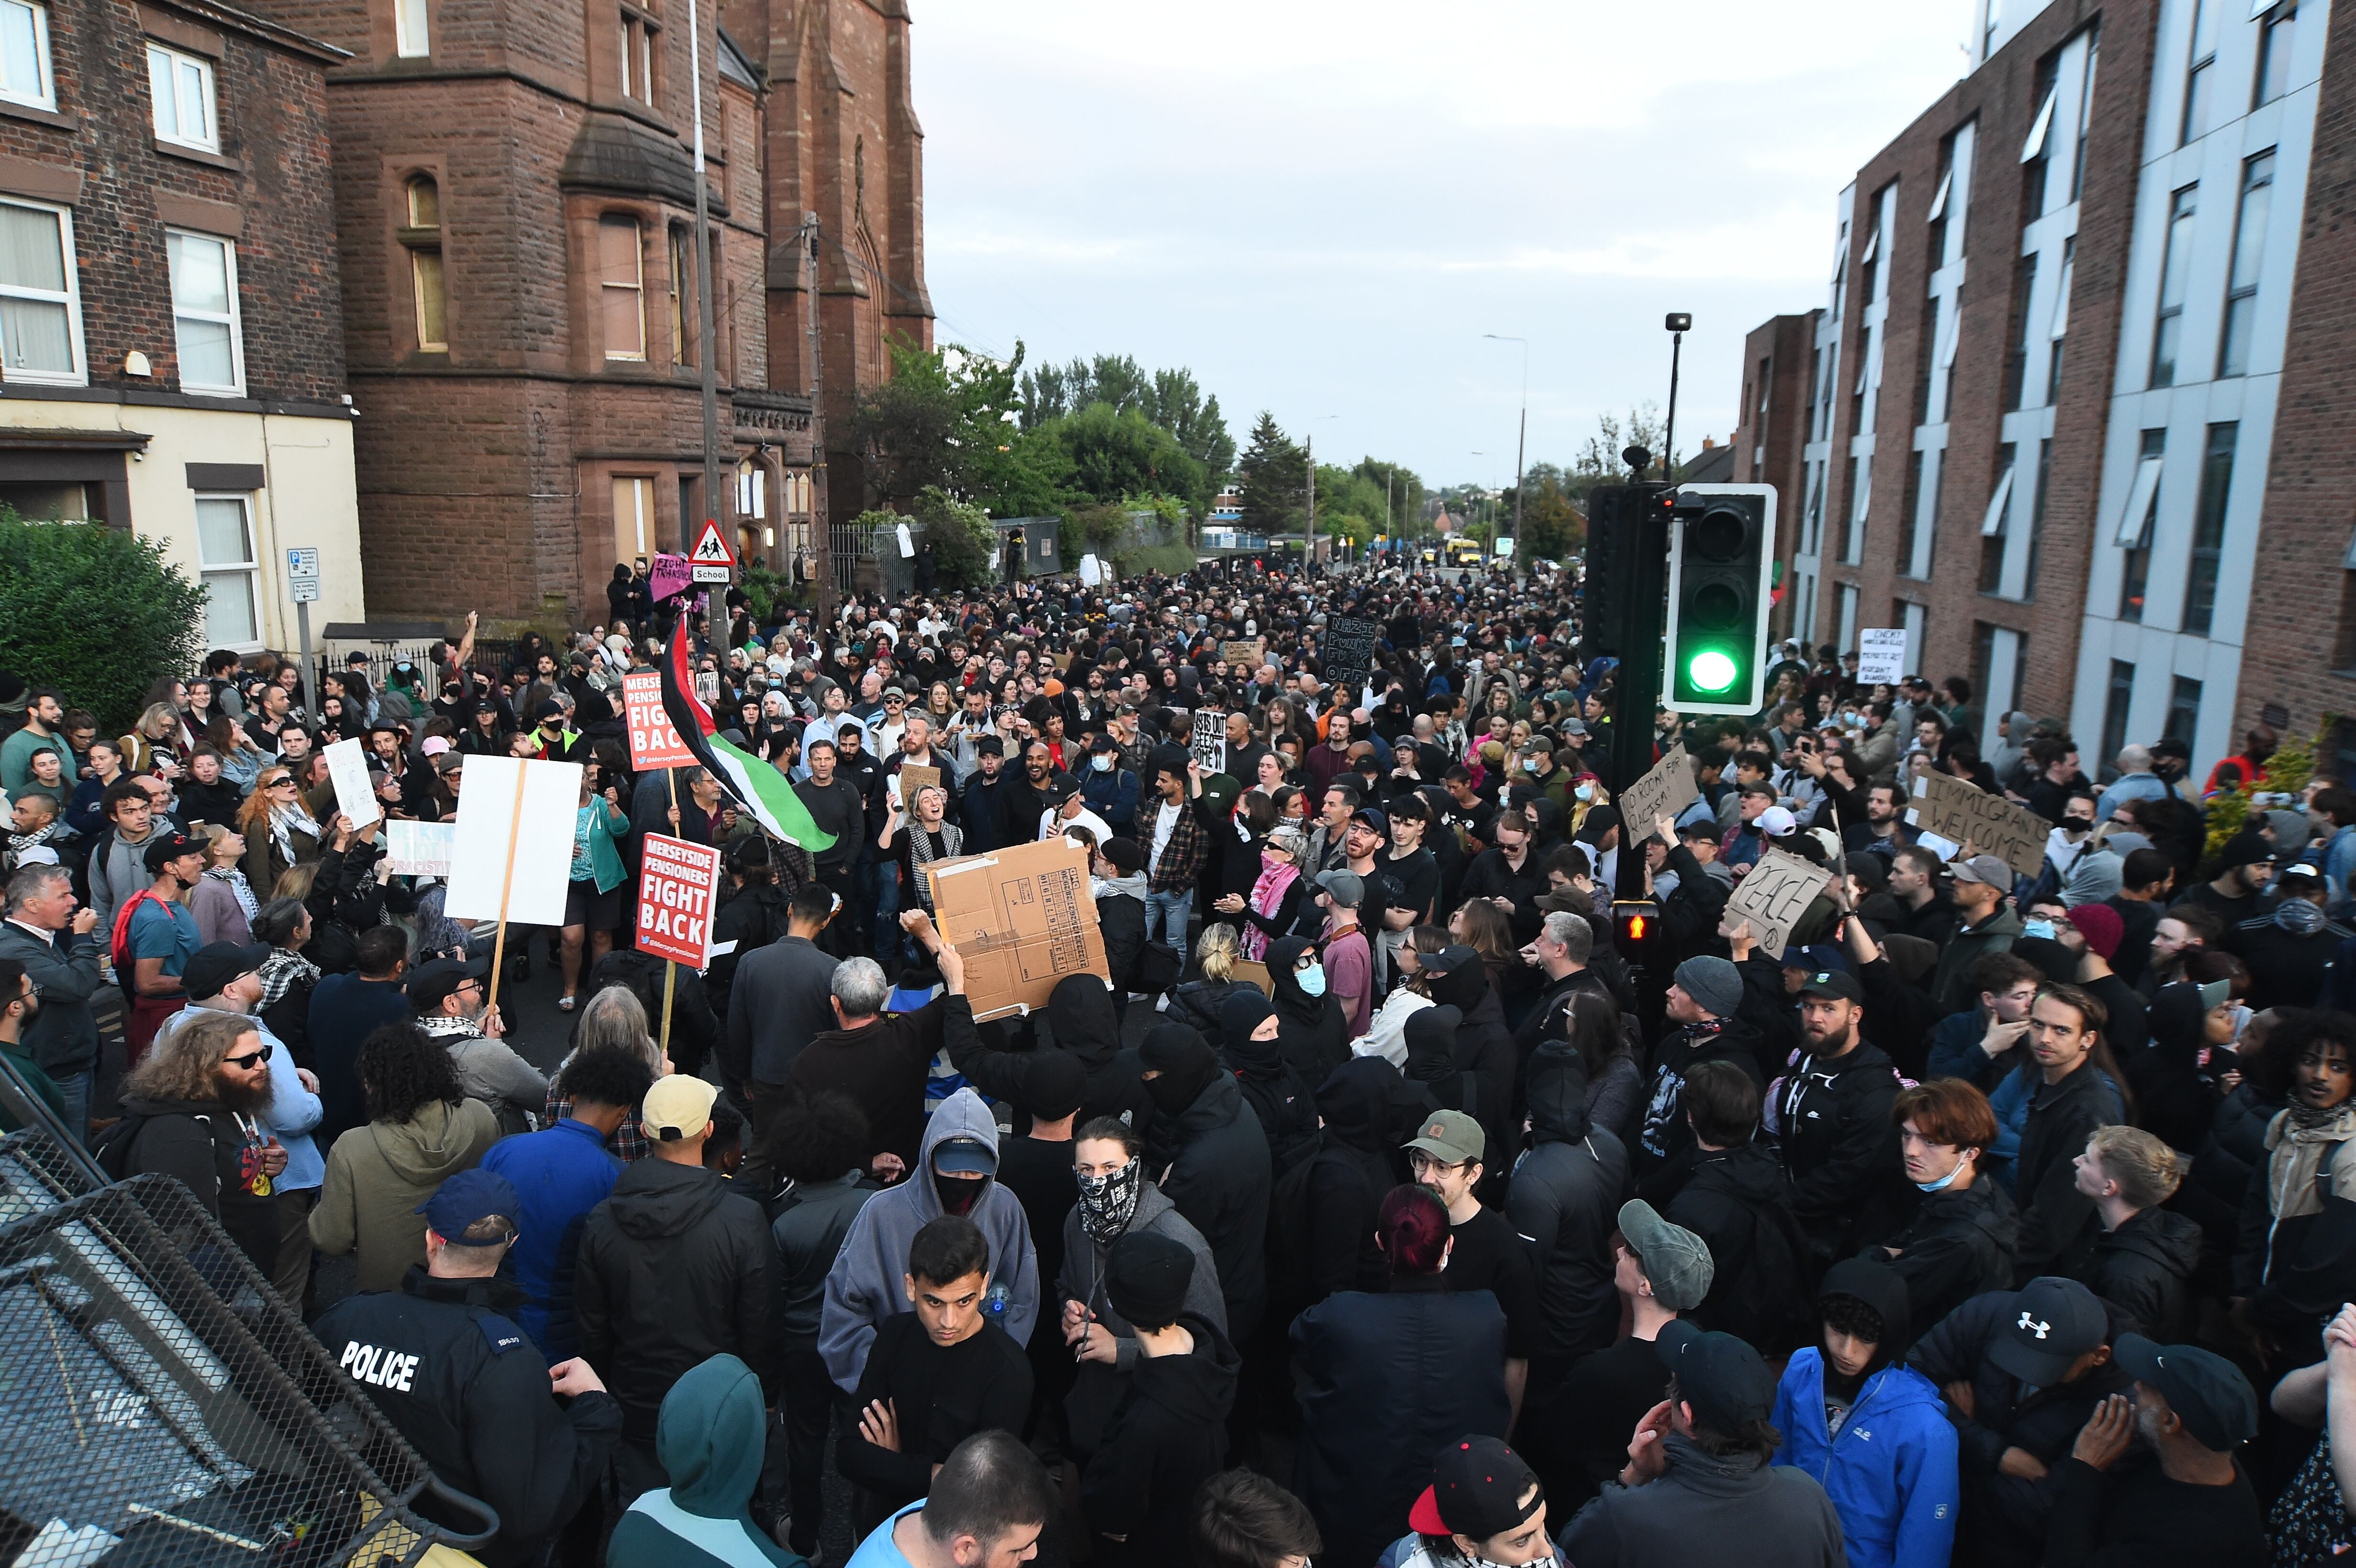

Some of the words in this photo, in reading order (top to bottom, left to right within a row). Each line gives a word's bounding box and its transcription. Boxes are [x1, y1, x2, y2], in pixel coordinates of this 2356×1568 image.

[657, 558, 687, 568] FIGHT
[697, 570, 726, 578] School
[1332, 617, 1375, 637] NAZI
[1329, 632, 1374, 653] PUNKS
[1327, 647, 1370, 668] FUCK
[1326, 665, 1370, 686] OFF!
[630, 704, 673, 728] FIG
[1212, 714, 1226, 735] OUT
[633, 727, 682, 752] BAC
[1622, 794, 1636, 814] NO
[1638, 771, 1665, 800] ROOM
[1666, 756, 1680, 776] FOR
[1629, 785, 1671, 839] RACISM!
[1931, 778, 2051, 842] IMMIGRANTS
[389, 822, 411, 840] BE
[1932, 805, 2031, 866] WELCOME
[646, 838, 712, 869] MERSEYSIDE
[644, 856, 710, 886] PENSIONERS
[1040, 875, 1048, 884] 10
[1060, 870, 1069, 881] 30
[643, 873, 708, 915] FIGHT
[1063, 881, 1071, 890] 29
[1065, 891, 1073, 901] 28
[1735, 865, 1821, 924] PEACE
[1067, 901, 1075, 911] 27
[1069, 911, 1077, 921] 26
[640, 903, 705, 946] BACK
[1072, 921, 1080, 930] 25
[649, 939, 700, 960] @MerseyPensioner
[1076, 939, 1083, 949] 23
[1078, 949, 1085, 958] 22
[1080, 958, 1087, 968] 21
[340, 1340, 419, 1392] POLICE
